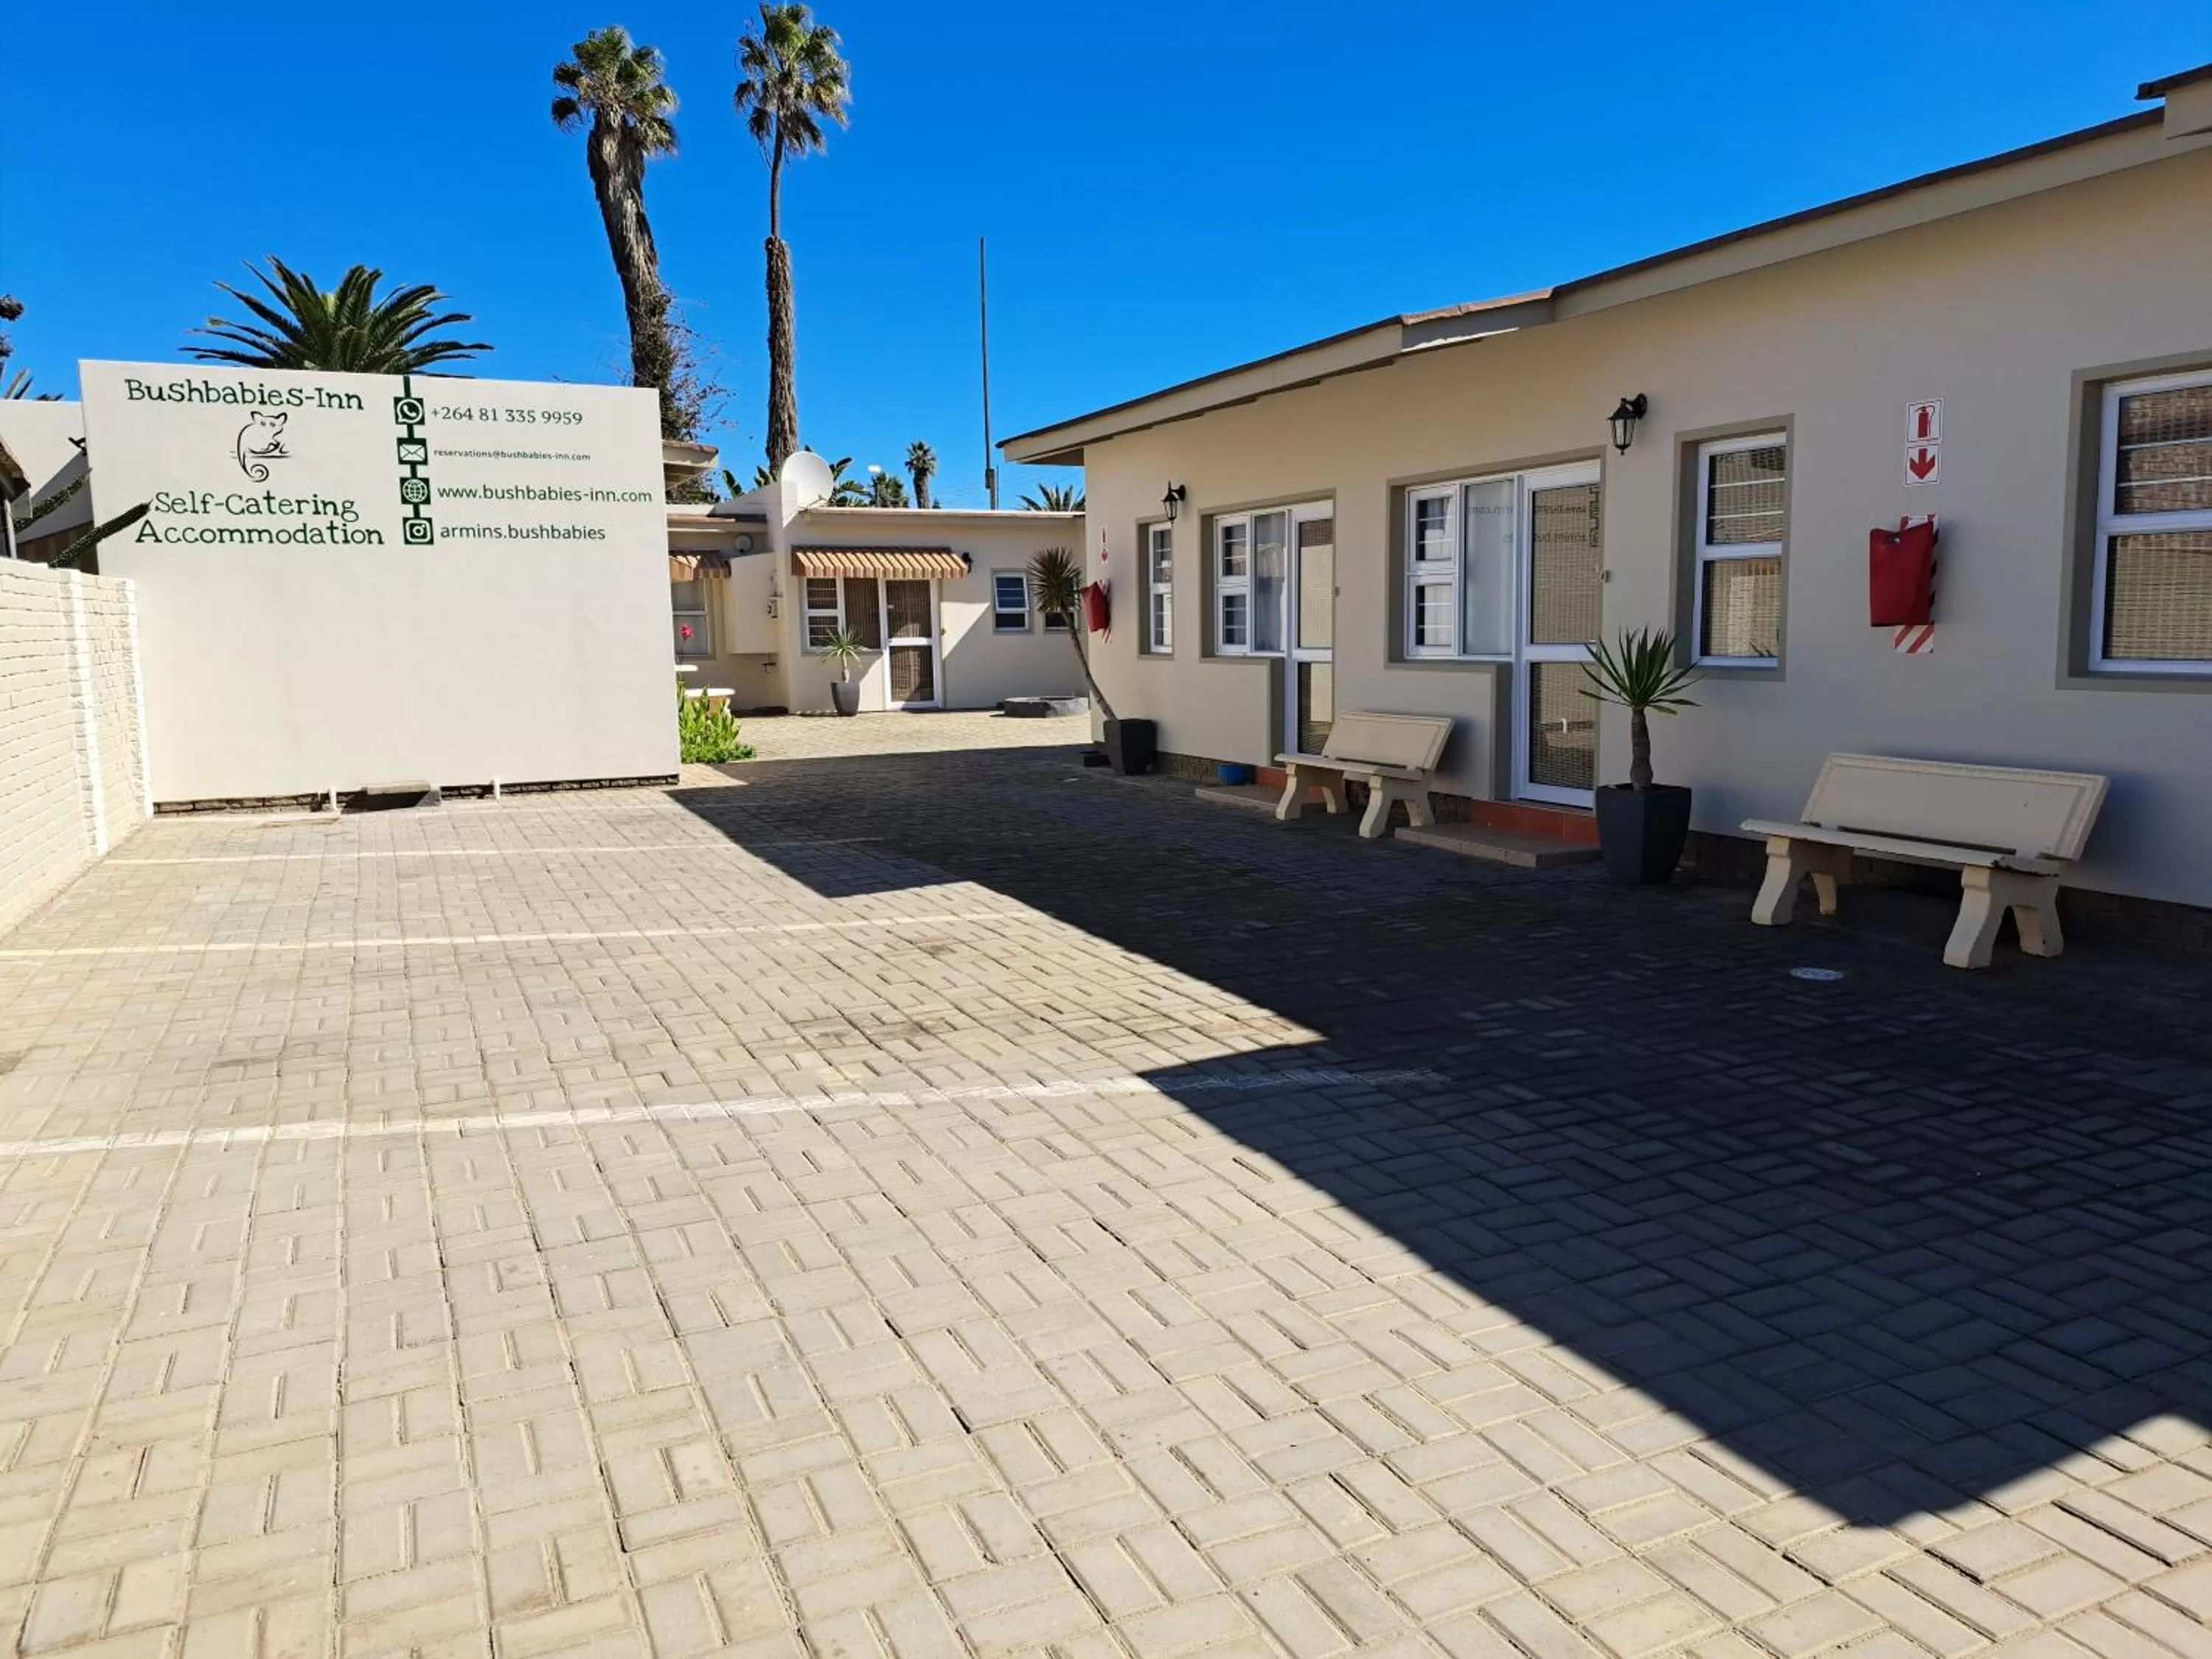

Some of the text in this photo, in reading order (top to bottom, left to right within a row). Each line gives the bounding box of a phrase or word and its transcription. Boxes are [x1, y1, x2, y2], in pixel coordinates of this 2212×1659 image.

[124, 378, 364, 411] Bushbabies-Inn
[431, 406, 583, 425] +264 81 335 9959
[433, 448, 591, 462] reservations@bushbabies-inn.com
[437, 484, 653, 503] www.bushbabies-inn.com
[154, 490, 360, 523] Self-Catering
[134, 519, 385, 546] Accommodation
[440, 523, 606, 540] armins.bushbabies
